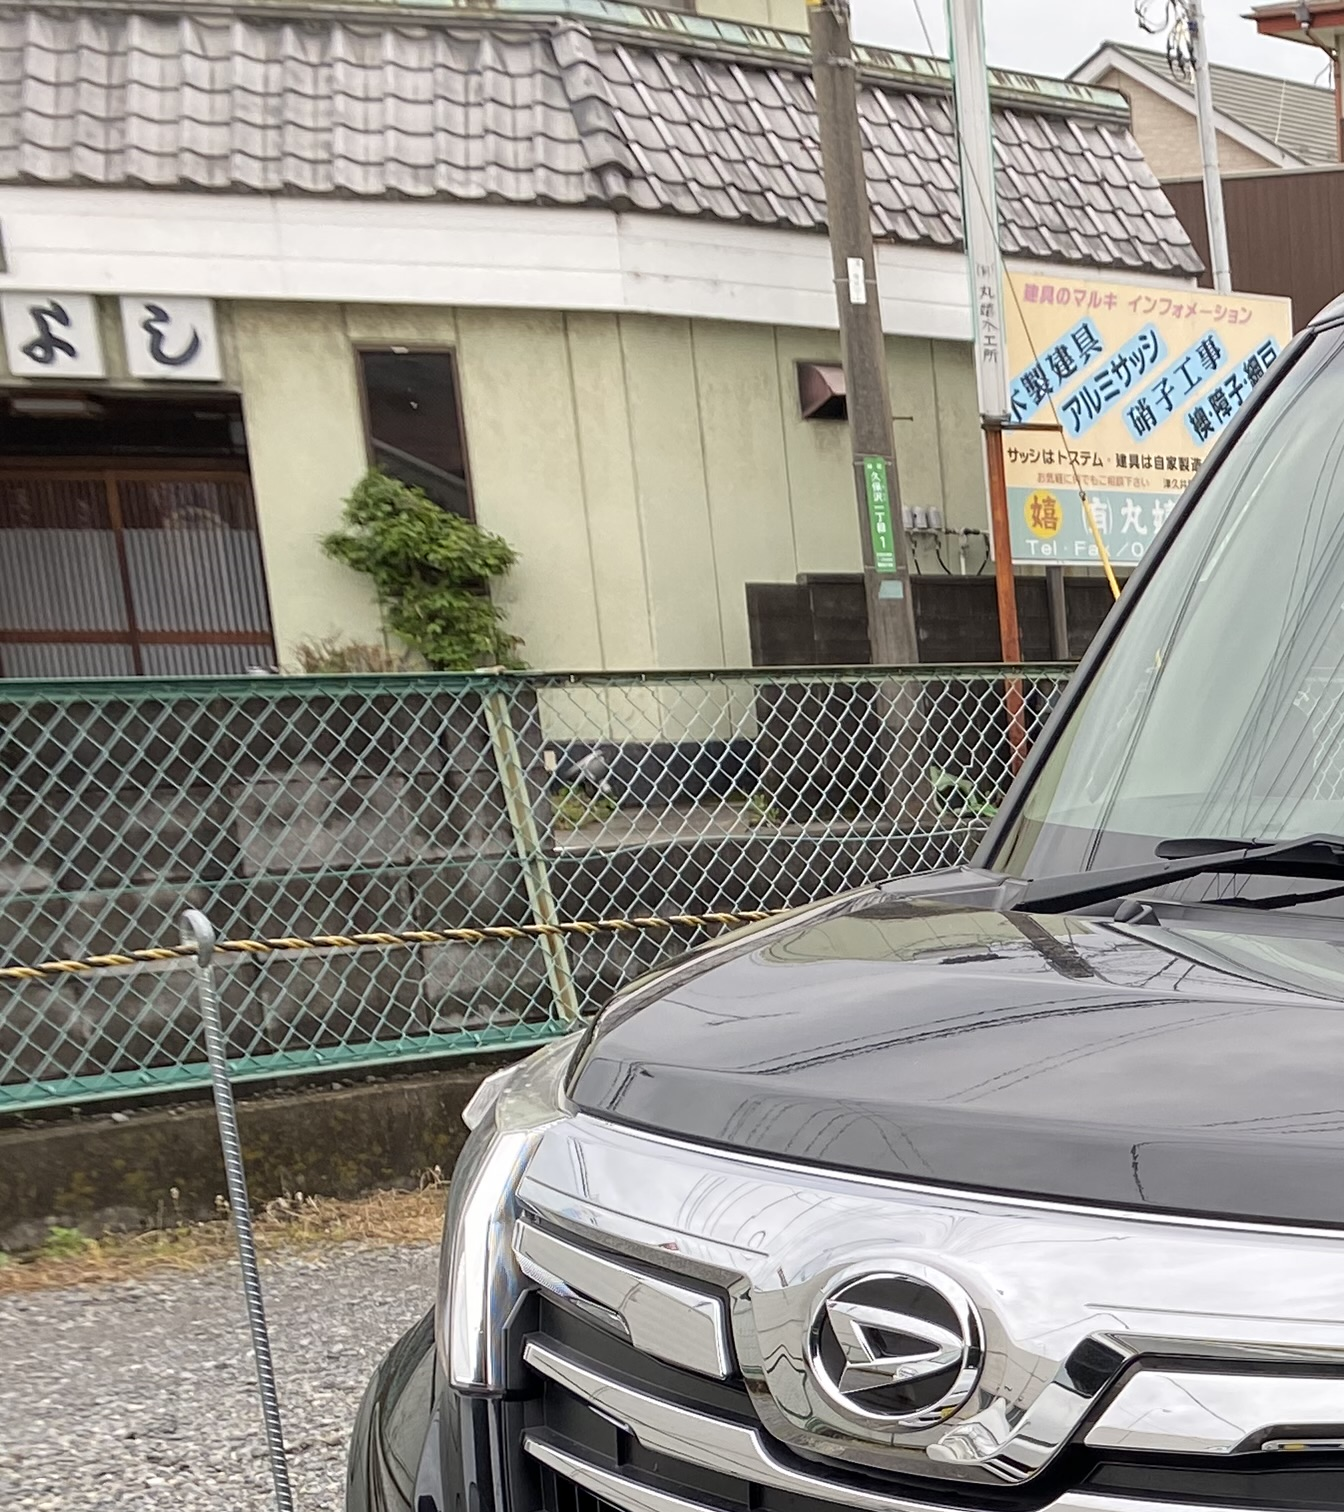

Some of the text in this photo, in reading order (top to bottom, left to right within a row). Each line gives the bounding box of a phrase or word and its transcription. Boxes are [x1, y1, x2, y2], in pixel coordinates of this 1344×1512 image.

[22, 299, 200, 366] よし
[1023, 282, 1253, 335] 建具のマルキ インフォメーション
[1061, 329, 1160, 433] アルミサッシ
[1126, 334, 1222, 437] 硝子工事
[1030, 495, 1058, 531] 嬉
